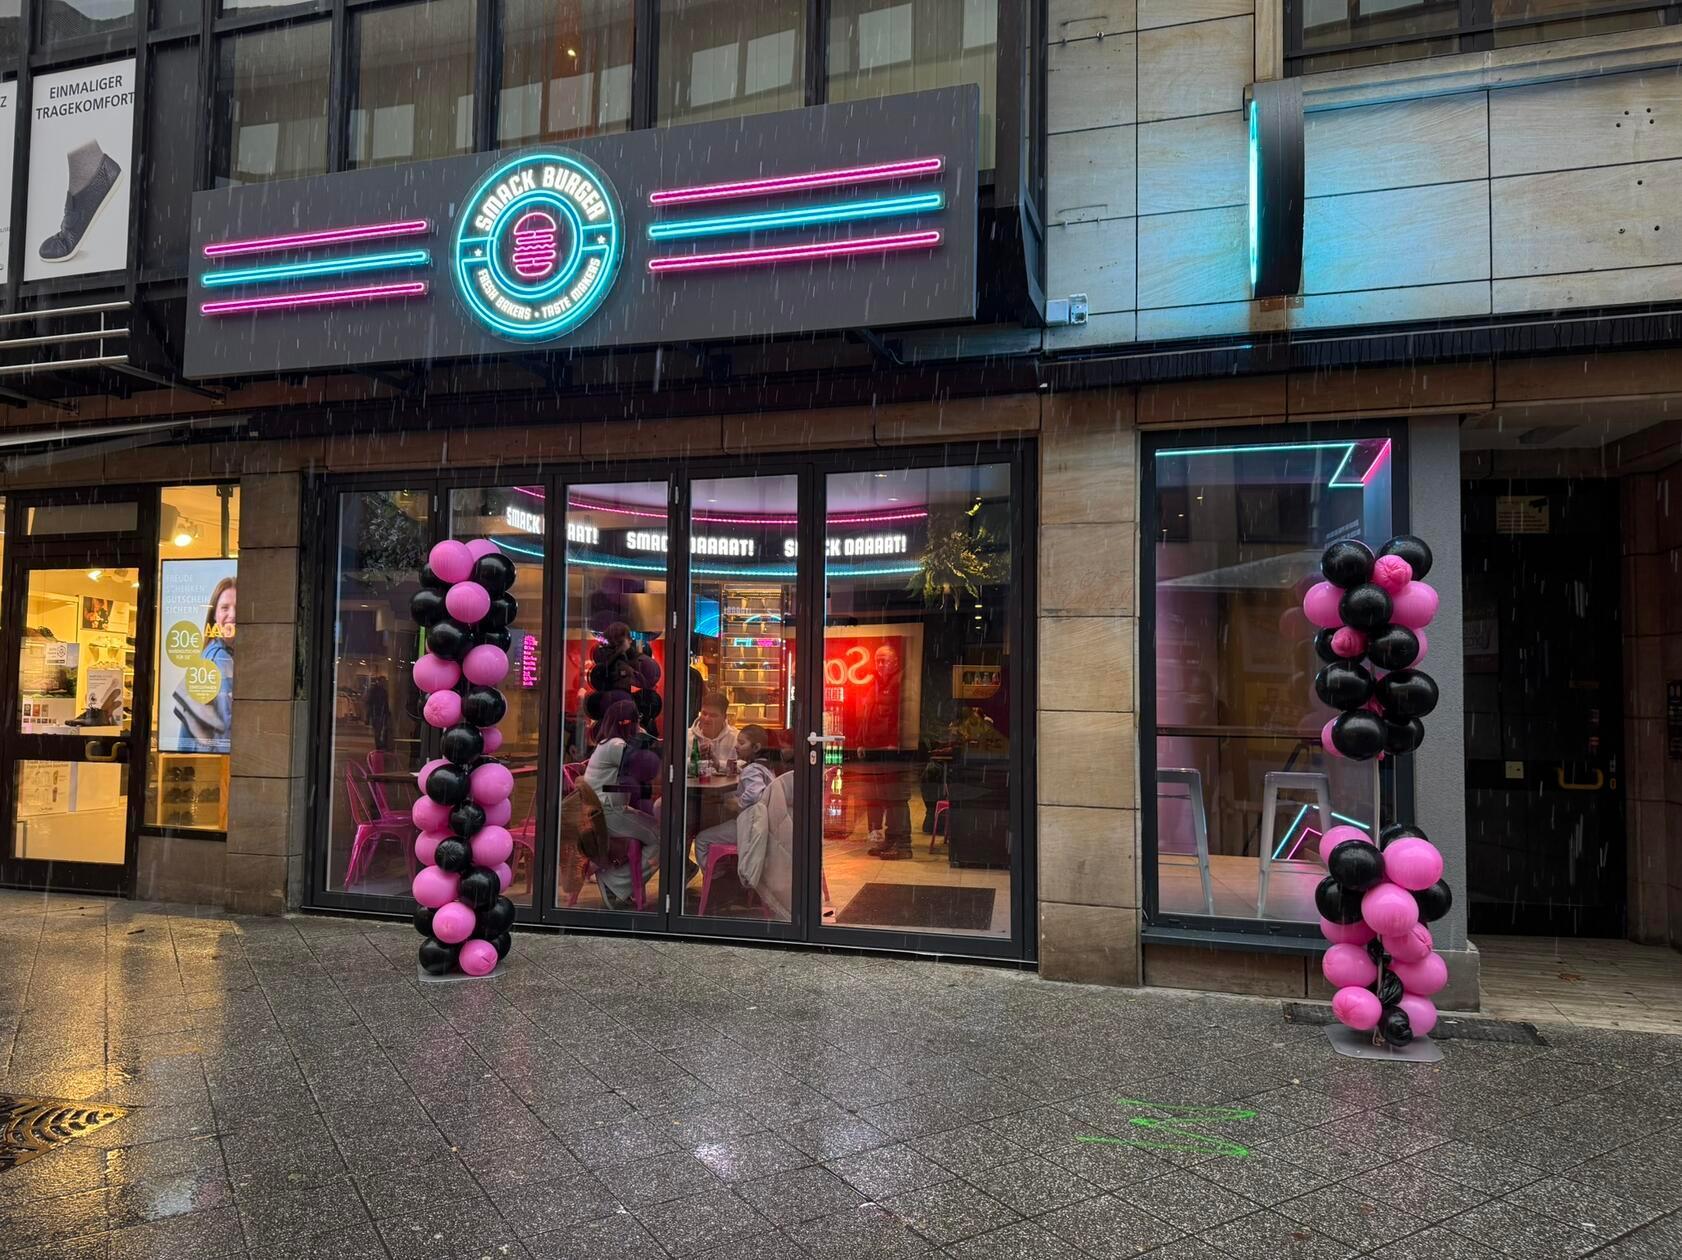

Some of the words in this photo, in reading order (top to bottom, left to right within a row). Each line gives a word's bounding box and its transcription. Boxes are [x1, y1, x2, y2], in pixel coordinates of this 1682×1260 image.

[49, 75, 123, 99] EINMALIGER
[36, 91, 135, 120] TRAGEKOMFORT
[475, 169, 537, 231] SMACK
[542, 166, 606, 221] BURGER
[478, 268, 499, 301] FRESH
[495, 293, 532, 320] BAKERS
[542, 296, 573, 319] TASTE
[570, 258, 601, 299] MAKERS
[506, 506, 541, 535] SMACK
[626, 530, 668, 552] SMAC
[170, 629, 200, 648] 30€
[189, 666, 217, 685] 30€
